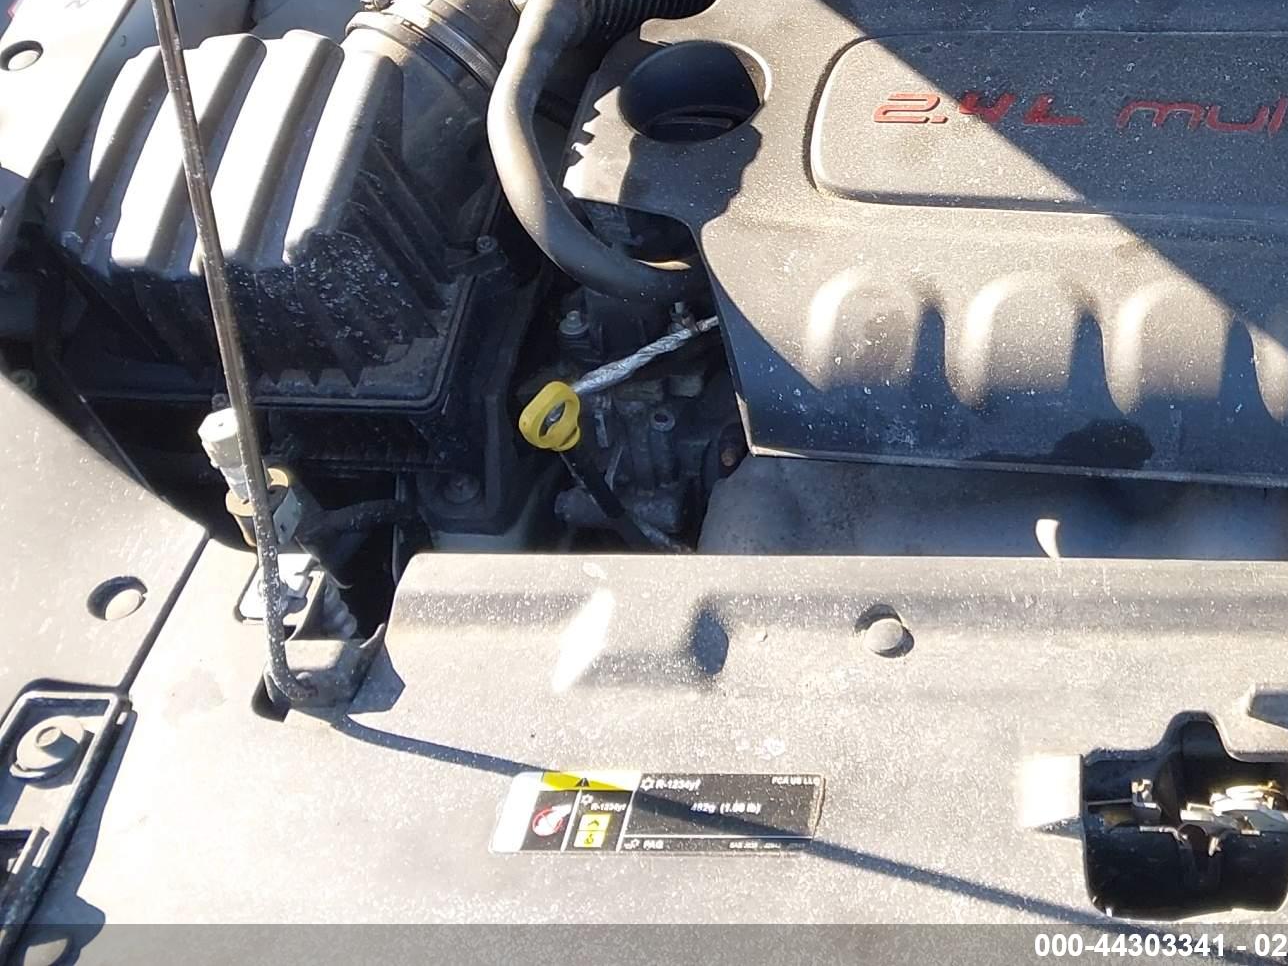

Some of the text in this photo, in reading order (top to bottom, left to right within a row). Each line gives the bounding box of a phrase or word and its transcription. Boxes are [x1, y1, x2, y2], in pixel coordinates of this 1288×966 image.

[655, 779, 701, 790] R-1234yf
[772, 776, 820, 785] FCA US LLC
[643, 840, 664, 850] PAG
